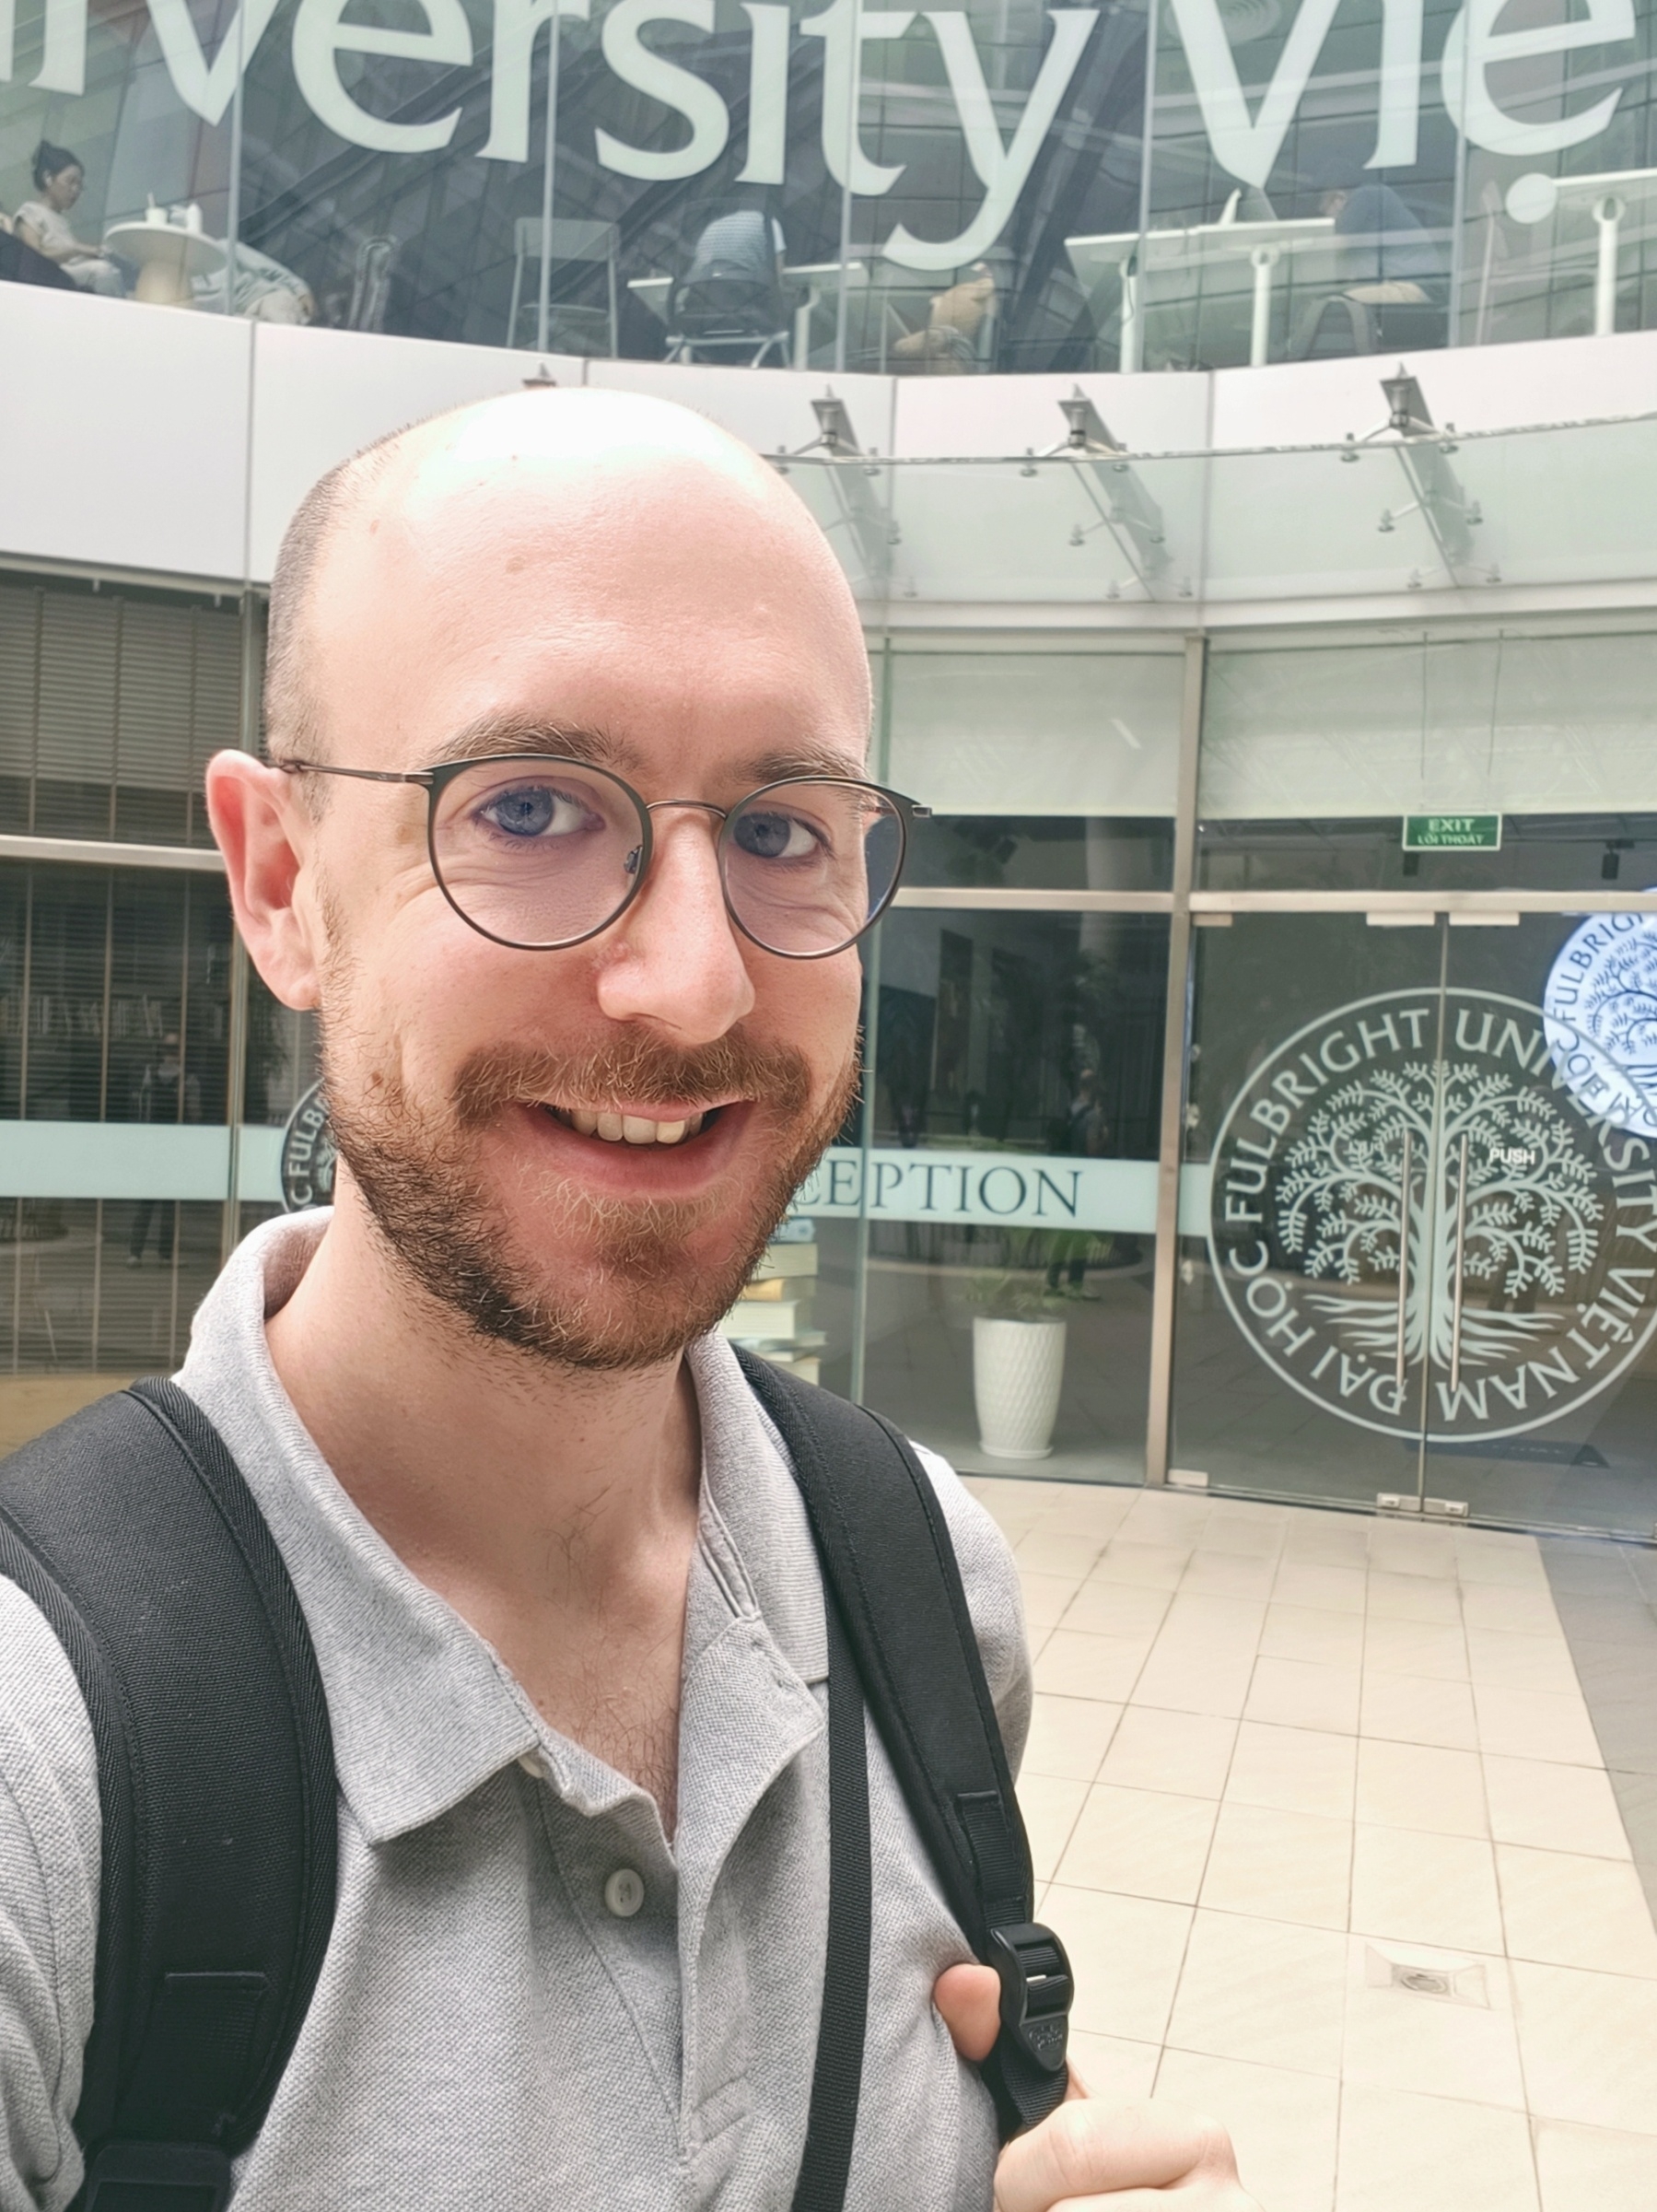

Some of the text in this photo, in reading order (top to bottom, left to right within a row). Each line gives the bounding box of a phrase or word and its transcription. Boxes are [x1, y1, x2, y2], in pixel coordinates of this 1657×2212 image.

[1429, 818, 1476, 833] EXIT
[1554, 913, 1643, 1021] FULBRIG
[1225, 1009, 1429, 1223] FULBRIGHT
[1455, 1009, 1657, 1254] UNIVERSITY
[1488, 1147, 1535, 1165] PUSH
[794, 1159, 1083, 1217] EPTION
[1229, 1240, 1316, 1358] HỌC
[1310, 1346, 1408, 1415] ĐẠI
